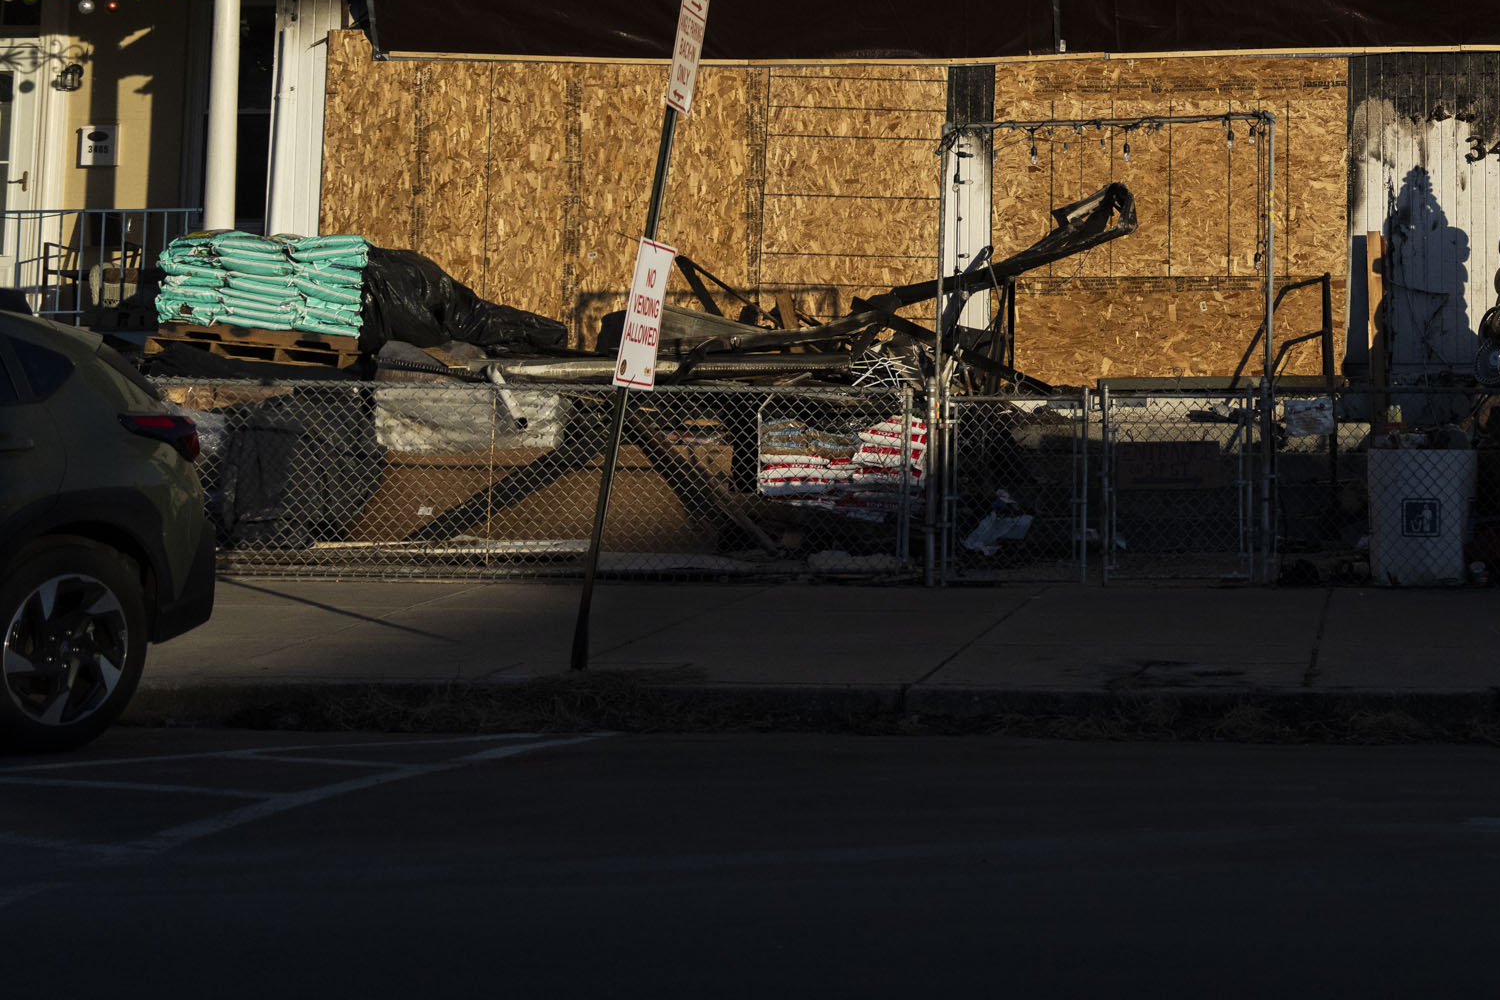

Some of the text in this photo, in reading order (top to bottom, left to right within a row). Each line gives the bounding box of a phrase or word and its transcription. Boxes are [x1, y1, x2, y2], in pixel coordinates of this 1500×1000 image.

[680, 38, 696, 63] BACK-IN
[677, 64, 691, 84] ONLY
[646, 268, 657, 289] NO
[633, 294, 659, 318] VENDING
[626, 322, 658, 346] ALLOWED
